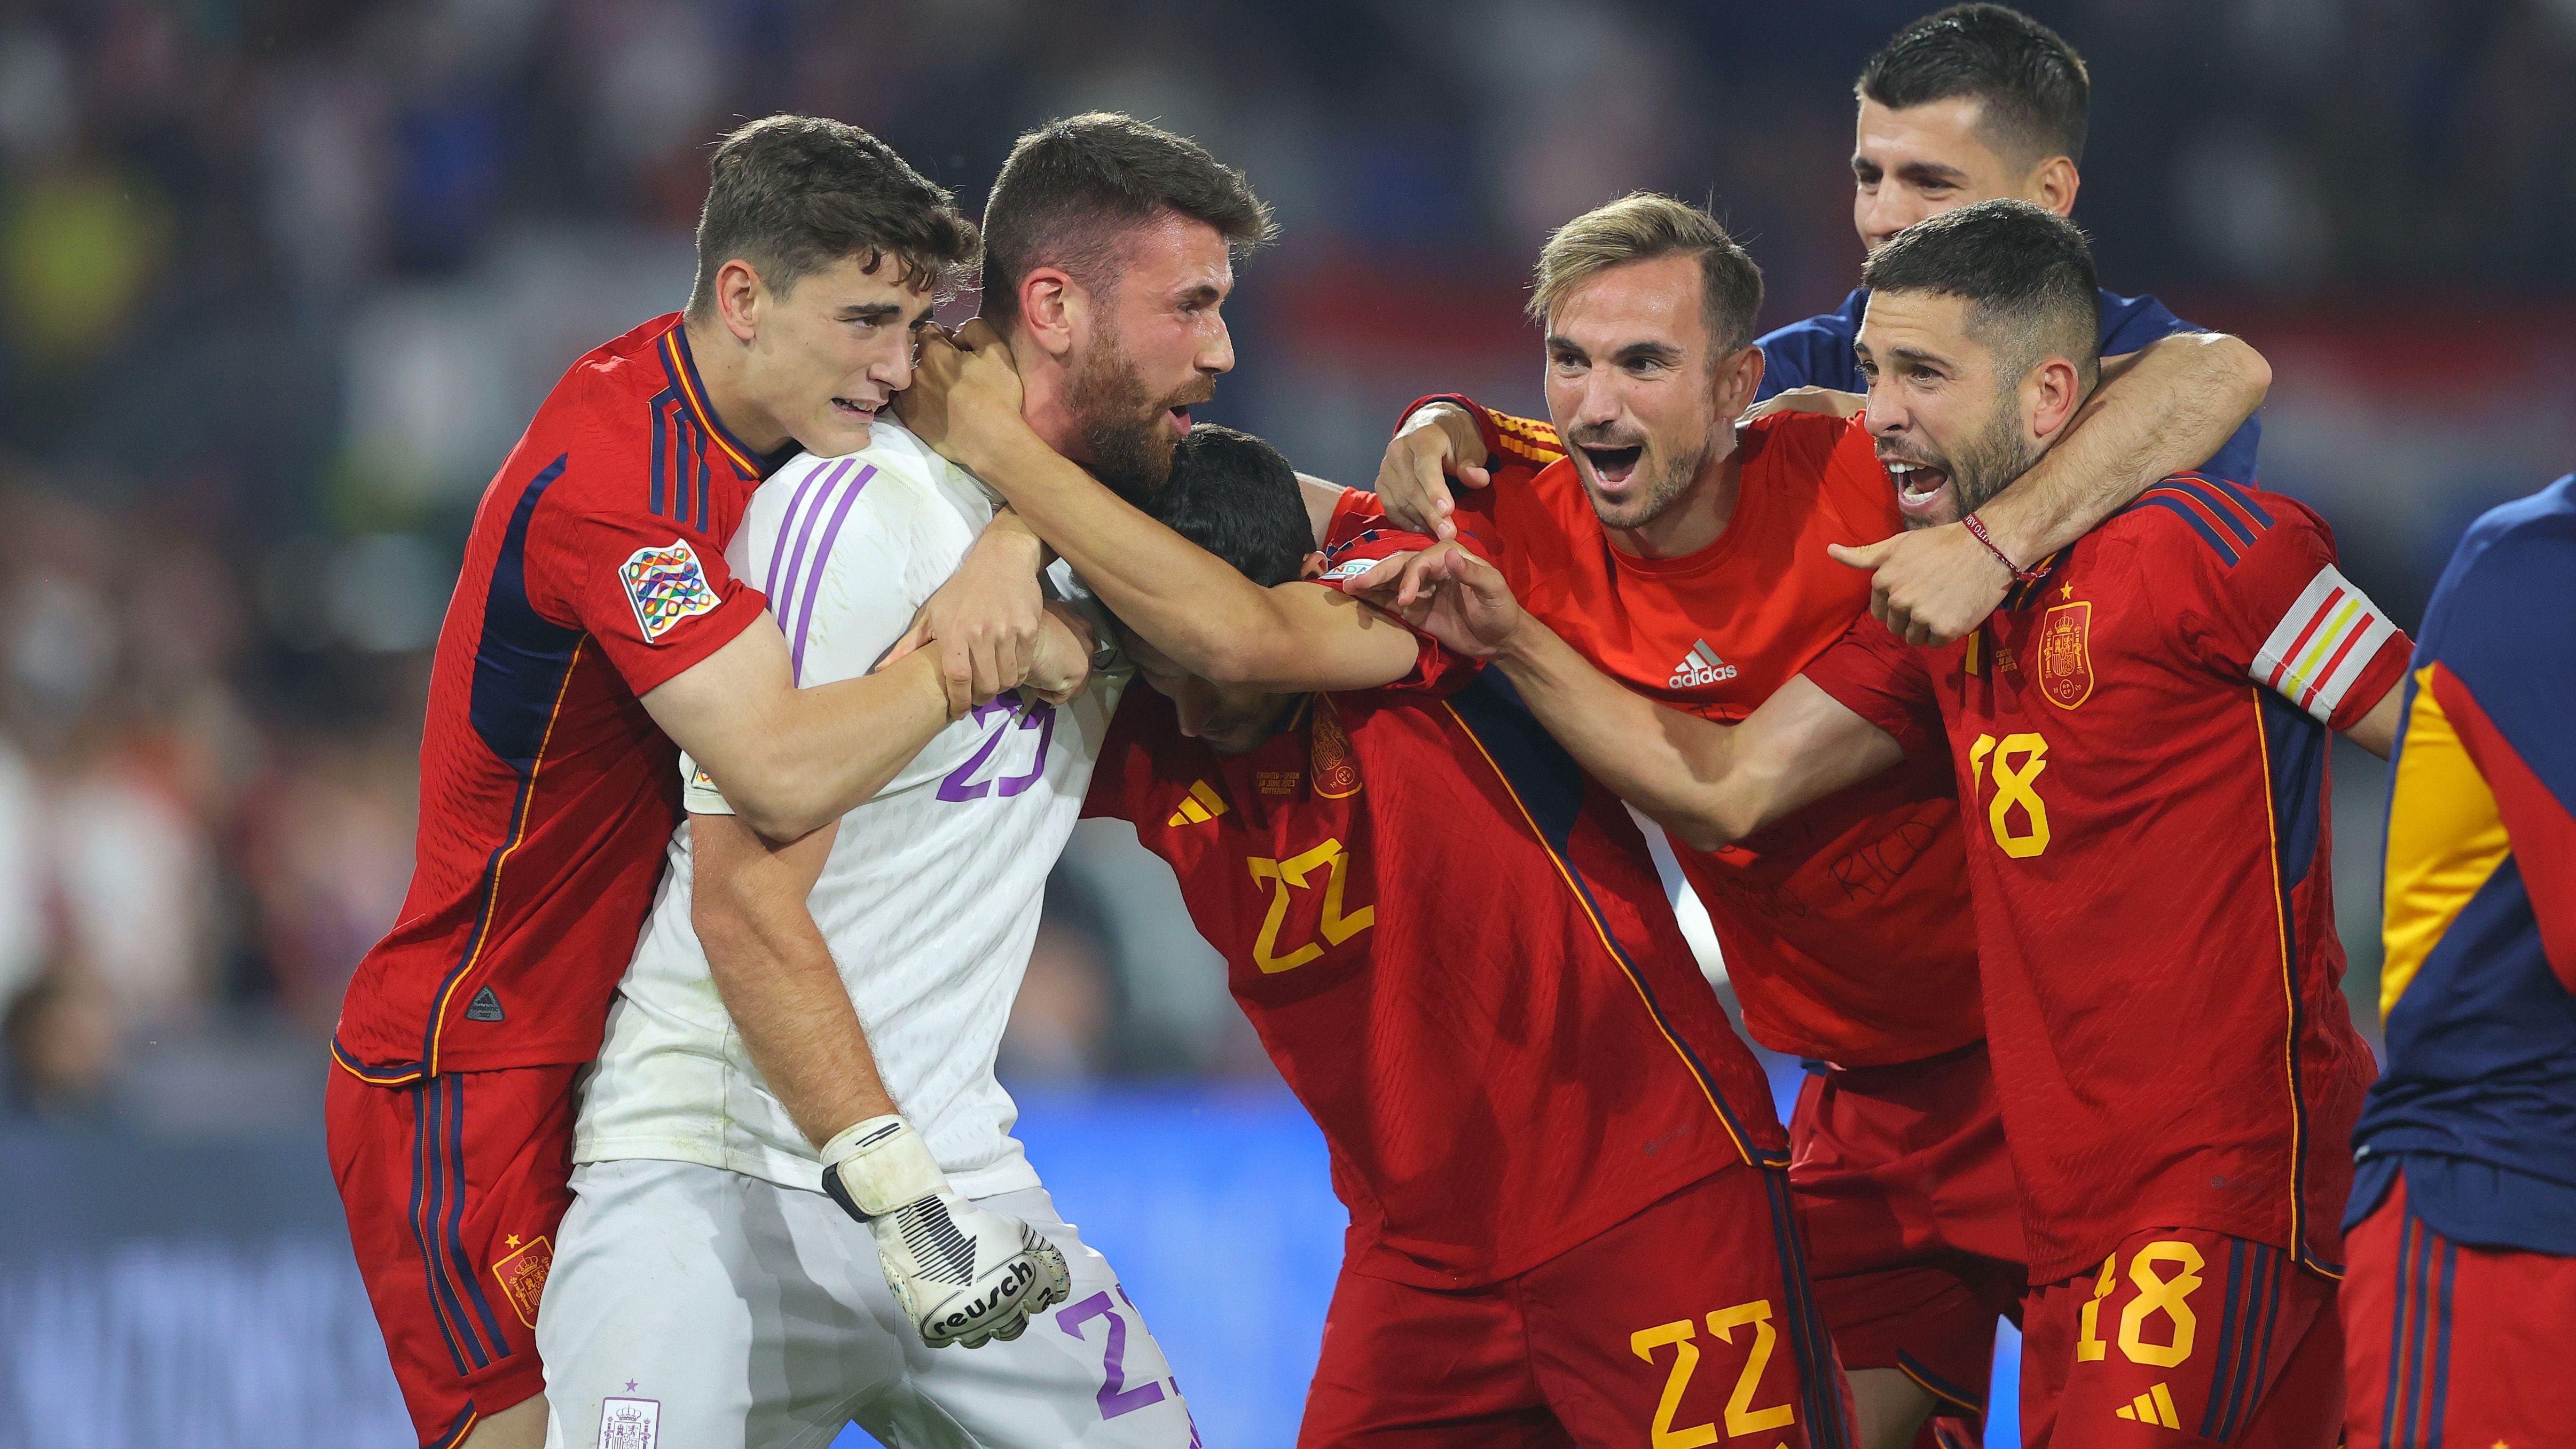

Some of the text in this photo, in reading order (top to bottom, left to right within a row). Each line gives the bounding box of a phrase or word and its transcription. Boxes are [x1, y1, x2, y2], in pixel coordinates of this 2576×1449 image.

[1669, 664, 1737, 689] adidas
[1969, 732, 2051, 858] 18
[1247, 837, 1375, 974] 22
[933, 1260, 1033, 1335] reusch
[2077, 1240, 2205, 1368] 18
[1630, 1299, 1795, 1449] 22
